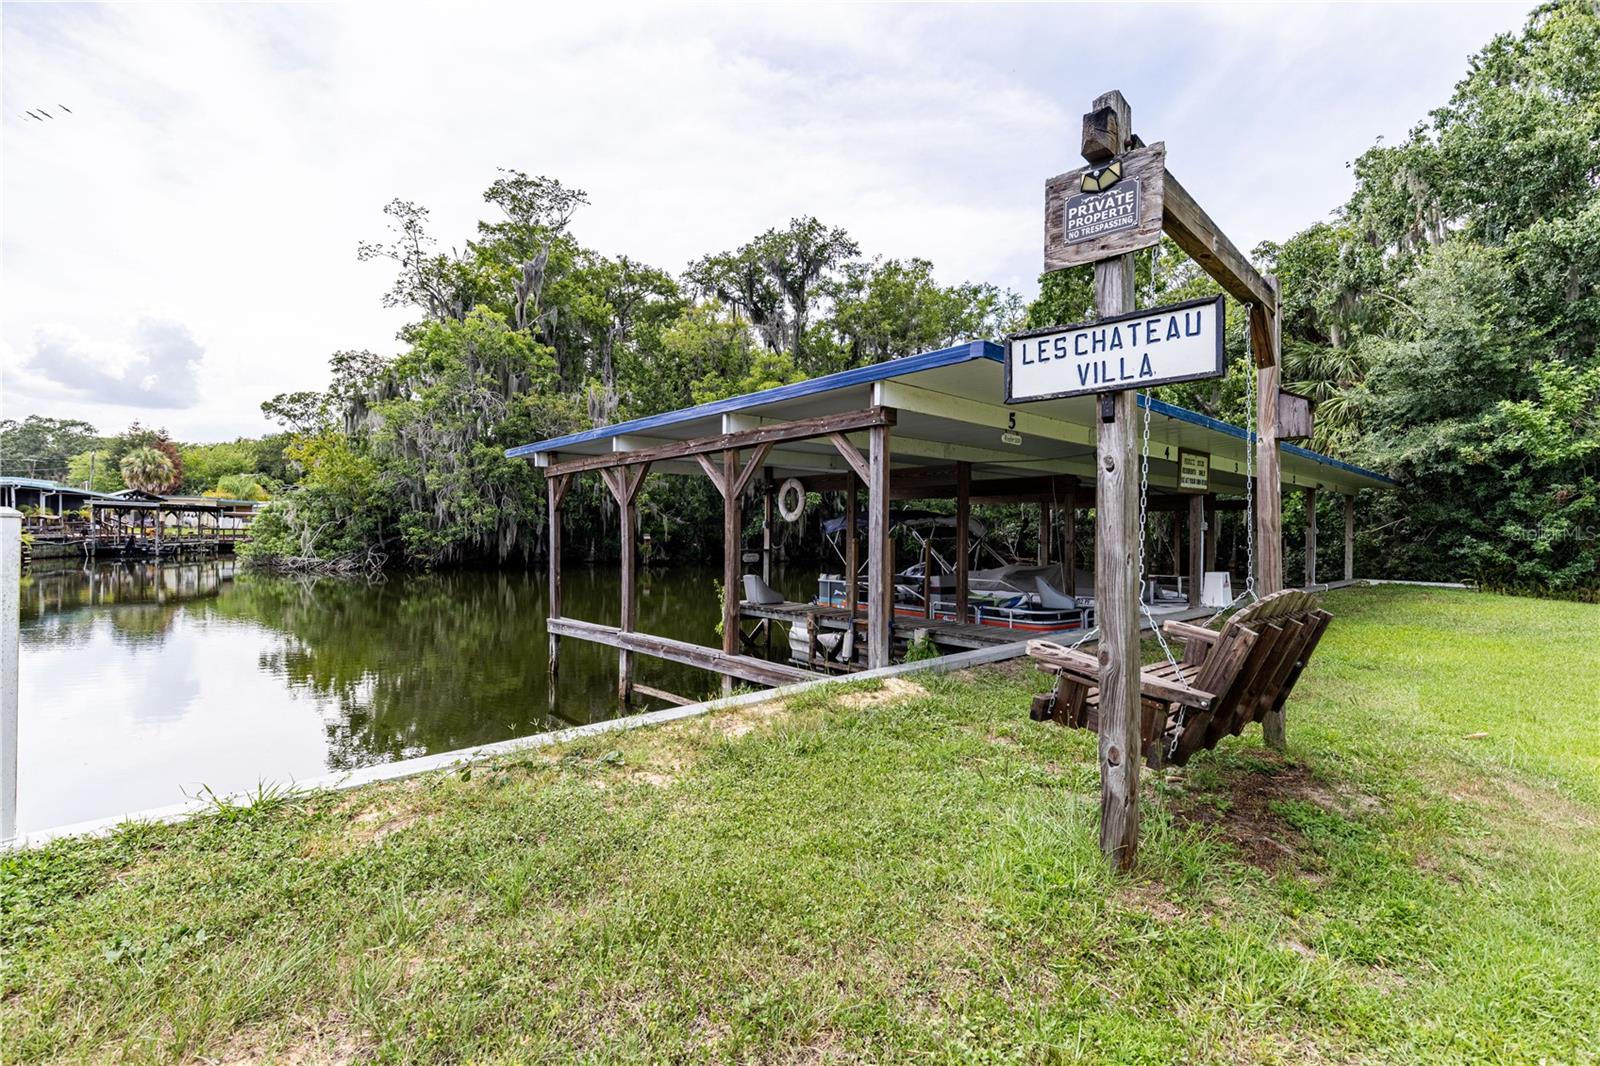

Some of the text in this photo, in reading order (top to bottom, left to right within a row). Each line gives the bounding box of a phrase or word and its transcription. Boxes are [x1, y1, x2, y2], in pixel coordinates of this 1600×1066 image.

[1068, 190, 1134, 219] PRIVATE
[1068, 203, 1134, 229] PROPERTY
[1068, 215, 1134, 239] NO TRESPASSING
[1022, 310, 1201, 365] LES CHATEAU
[1077, 352, 1153, 386] VILLA
[1008, 411, 1016, 430] 5
[1165, 446, 1170, 460] 4
